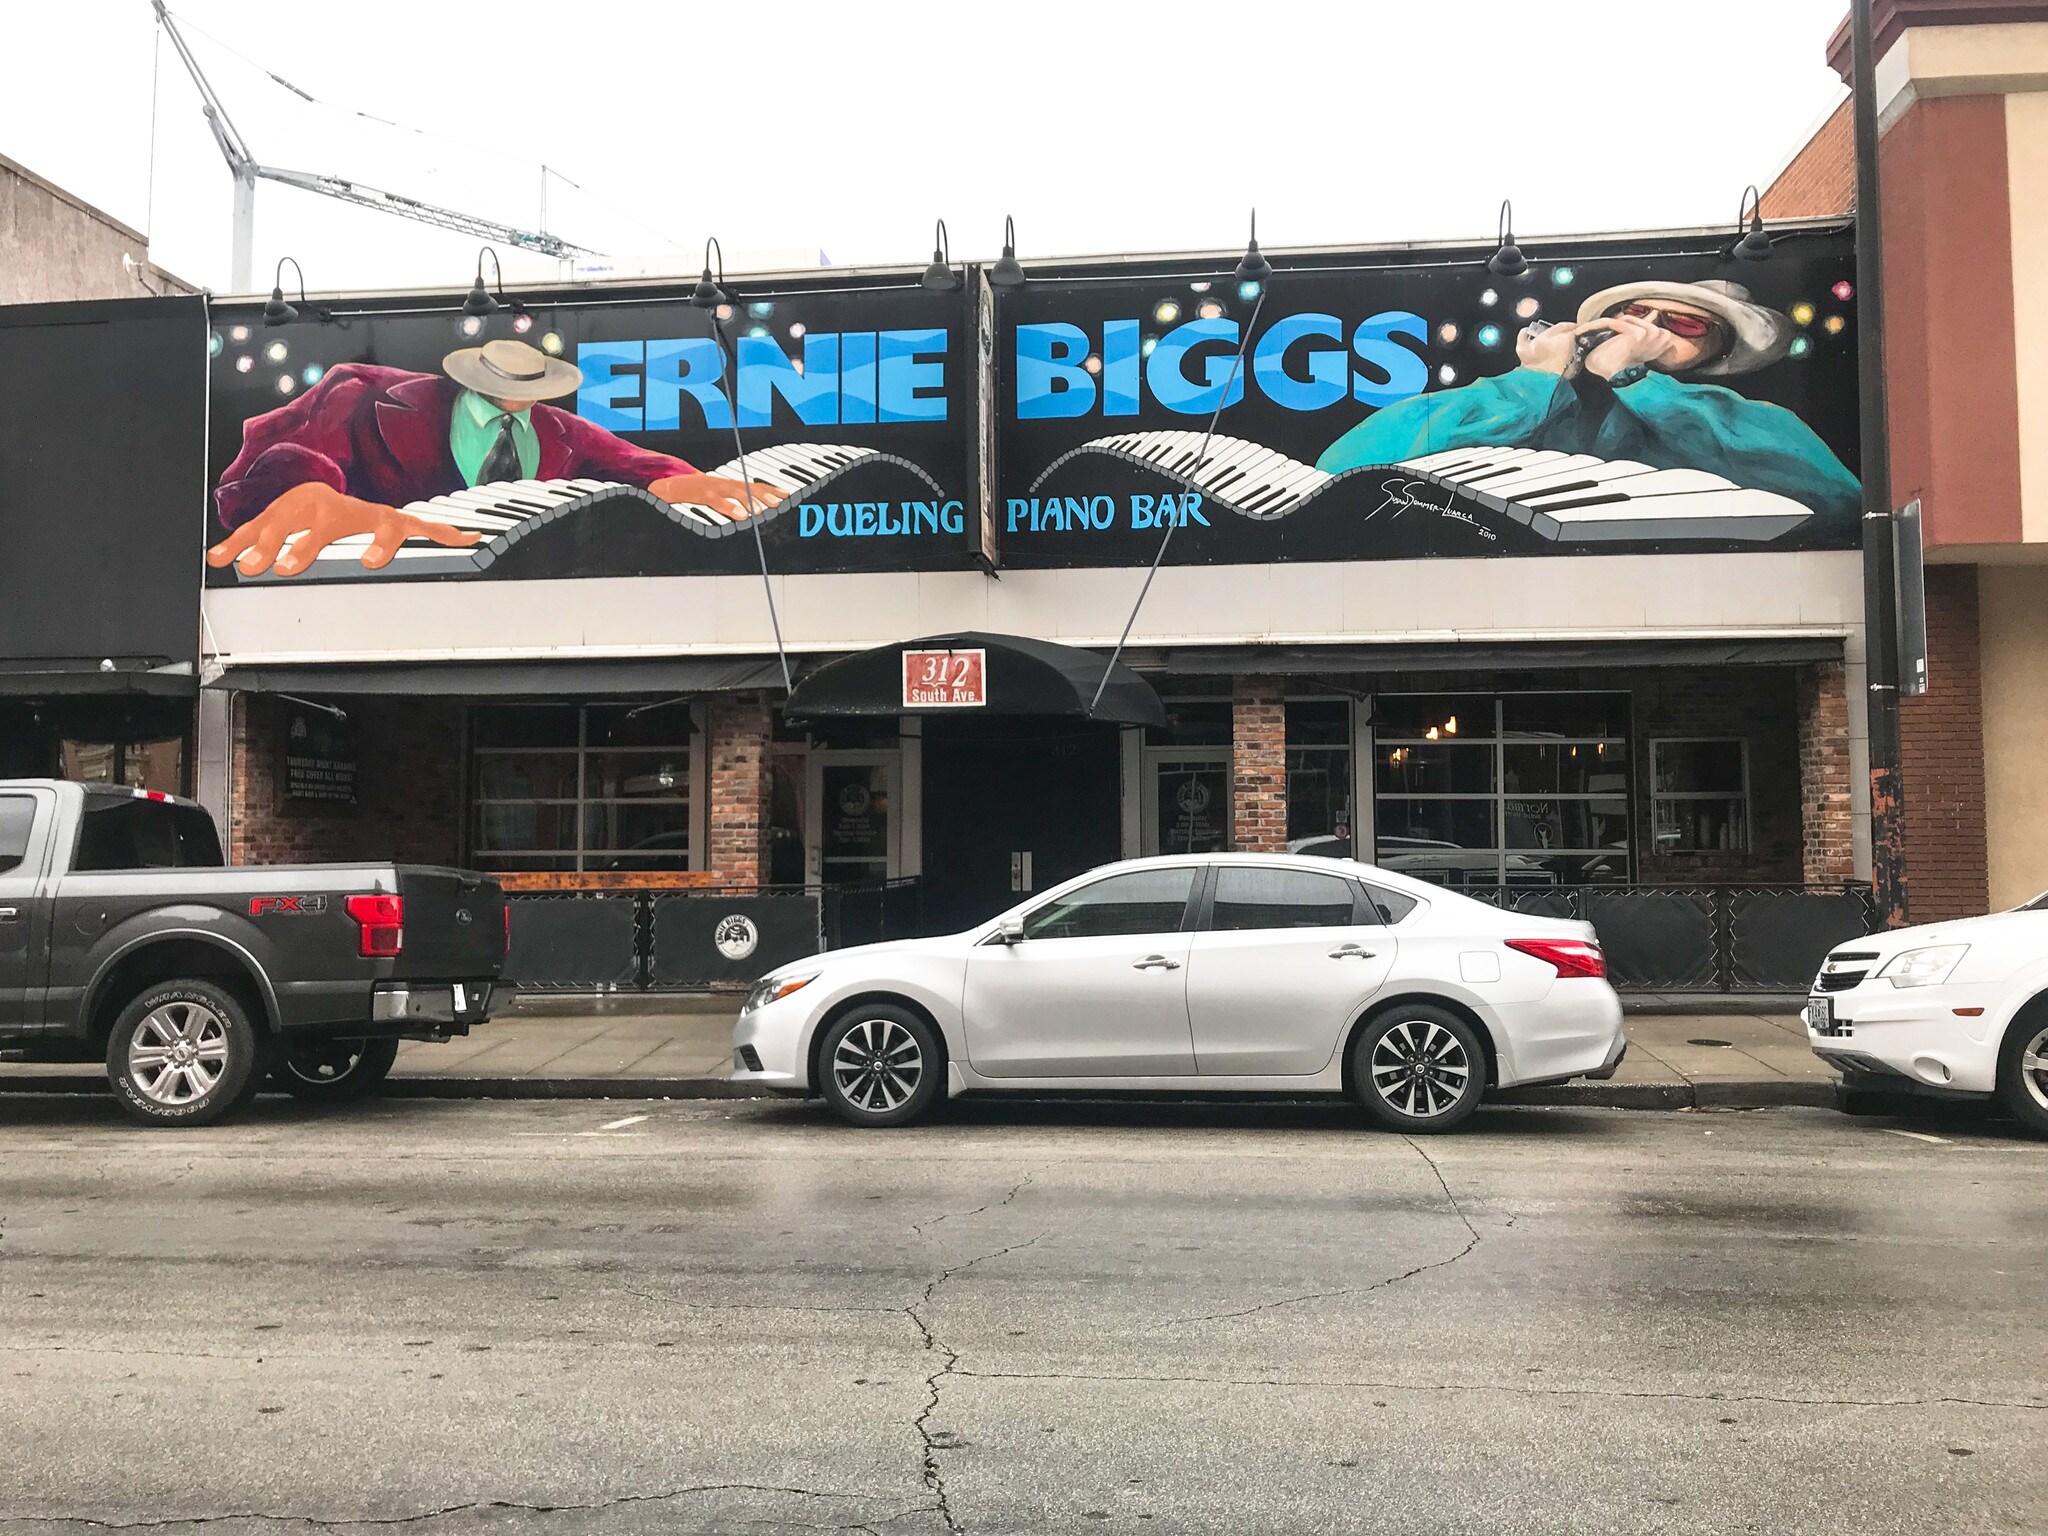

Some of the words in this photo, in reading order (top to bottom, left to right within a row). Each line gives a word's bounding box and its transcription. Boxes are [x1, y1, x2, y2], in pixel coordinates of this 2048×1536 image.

[577, 328, 947, 431] ERNIE
[1016, 311, 1428, 419] BIGGS
[799, 501, 964, 538] DUELING
[1007, 496, 1115, 532] PIANO
[1130, 493, 1211, 529] BAR
[1478, 528, 1497, 541] 2010
[922, 656, 970, 687] 312
[912, 688, 947, 702] South
[952, 688, 978, 702] Ave.
[249, 895, 328, 916] FX4
